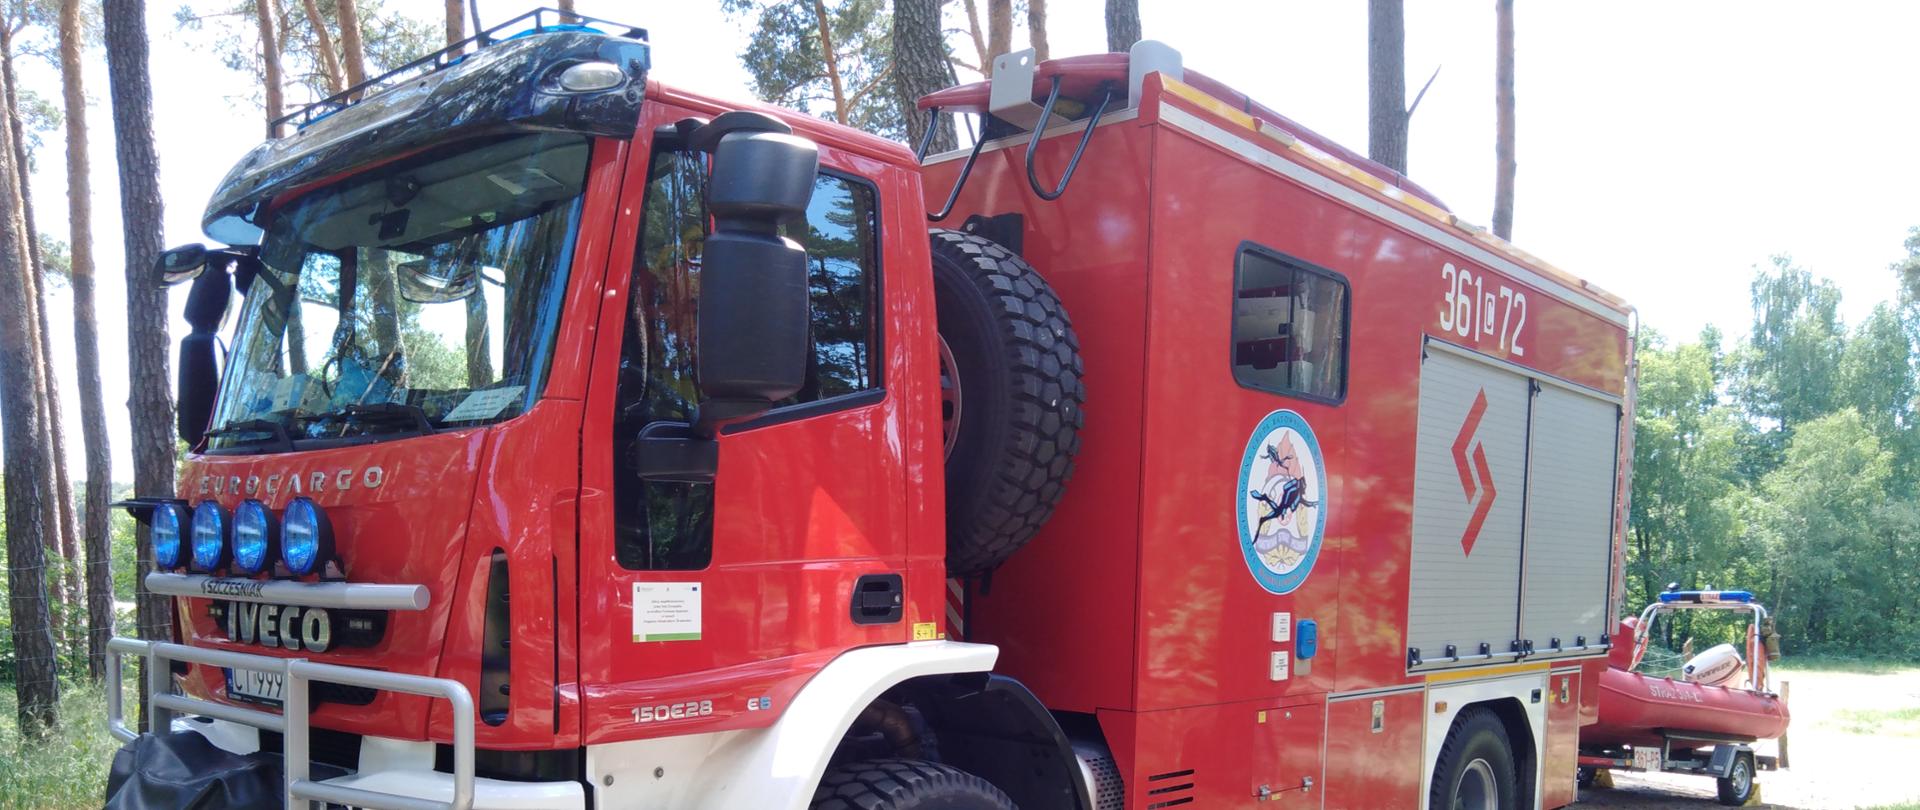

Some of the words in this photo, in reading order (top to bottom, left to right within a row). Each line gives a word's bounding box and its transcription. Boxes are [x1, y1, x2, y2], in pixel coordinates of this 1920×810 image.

[199, 466, 384, 495] EUROCARGO
[227, 601, 331, 653] IVECO
[631, 699, 713, 724] 150E28
[746, 696, 772, 711] E6
